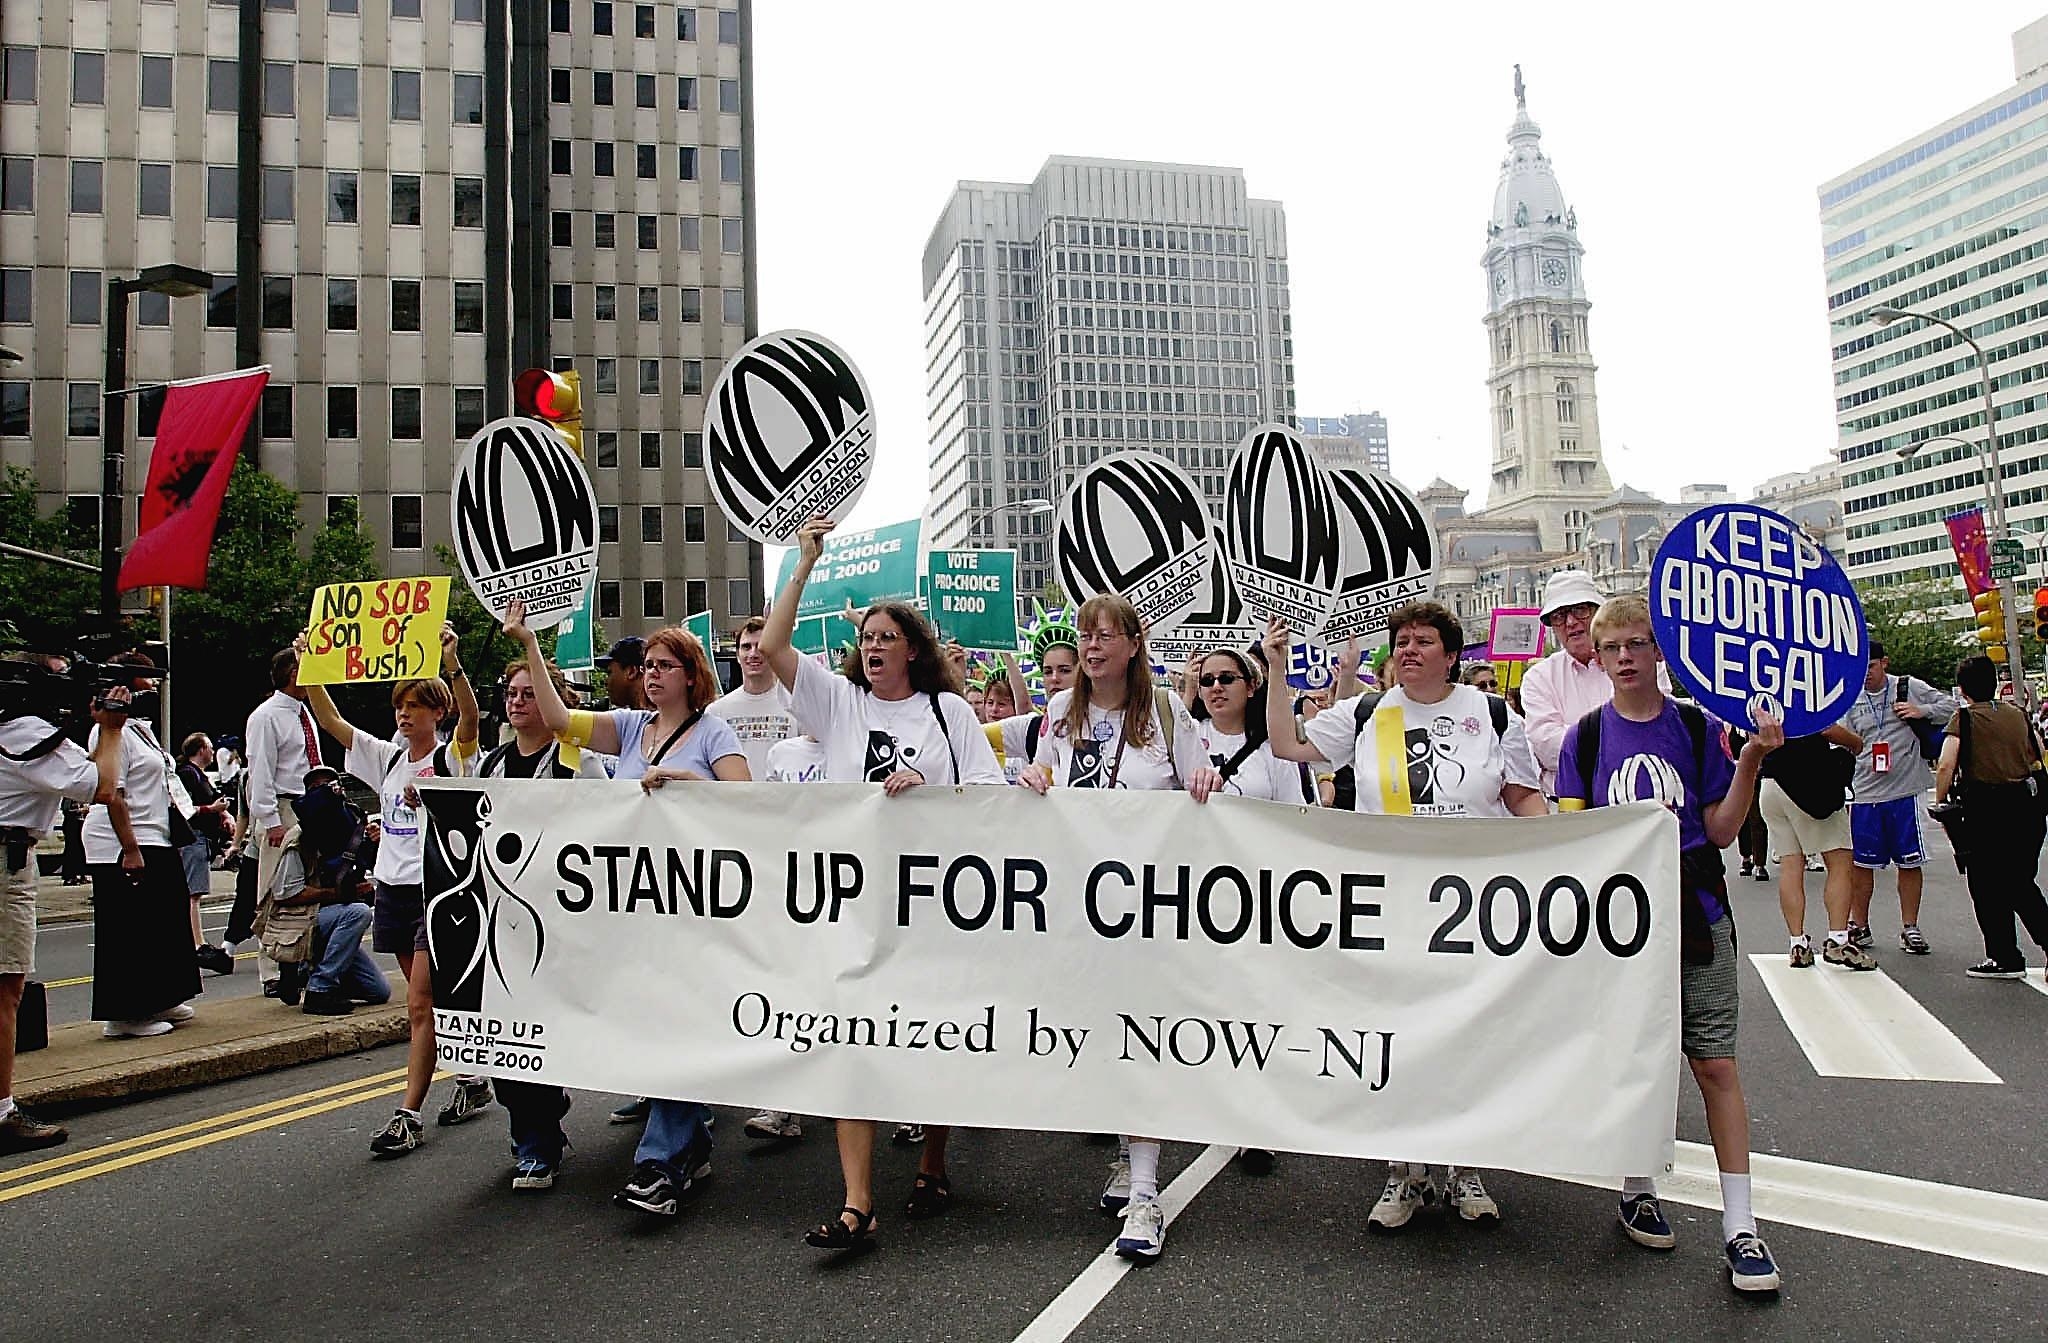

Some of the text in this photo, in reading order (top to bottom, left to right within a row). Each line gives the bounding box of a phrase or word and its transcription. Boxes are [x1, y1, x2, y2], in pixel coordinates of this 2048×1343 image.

[709, 337, 867, 526] NOW
[758, 427, 869, 534] NATIONAL
[774, 448, 867, 539] ORGANIZATION
[817, 472, 863, 514] WOMEN
[457, 426, 593, 578] NOW
[1227, 431, 1340, 591] NOW
[828, 531, 876, 550] VOTE
[1058, 458, 1207, 608] NOW
[1696, 511, 1823, 580] KEEP
[481, 557, 589, 594] NATIONAL
[834, 559, 881, 580] 2000
[947, 552, 978, 569] VOTE
[1127, 551, 1206, 606] TIONAL
[491, 576, 582, 607] ORGANIZATION
[935, 573, 1000, 592] PRO-CHOICE
[1135, 569, 1202, 614] ANIZATION
[1235, 567, 1326, 609] NATIONAL
[322, 585, 362, 619] NO
[528, 595, 572, 612] WOMEN
[942, 595, 952, 611] IN
[953, 595, 986, 613] 2000
[1150, 589, 1195, 620] WOMEN
[1241, 587, 1317, 623] ORGANIZATION
[1660, 557, 1859, 657] ABORTION
[382, 615, 413, 646] Of
[1172, 628, 1250, 640] TIONAL
[1324, 618, 1389, 642] FOR WOM
[345, 641, 425, 680] Bush)
[1679, 625, 1844, 712] LEGAL
[1607, 753, 1685, 808] NOW
[556, 843, 1651, 958] STAND UP FOR CHOICE 2000
[437, 1013, 544, 1040] TAND UP
[464, 1034, 496, 1048] FOR
[732, 992, 997, 1053] Organized
[1027, 1007, 1091, 1069] by
[493, 1051, 543, 1072] 2000
